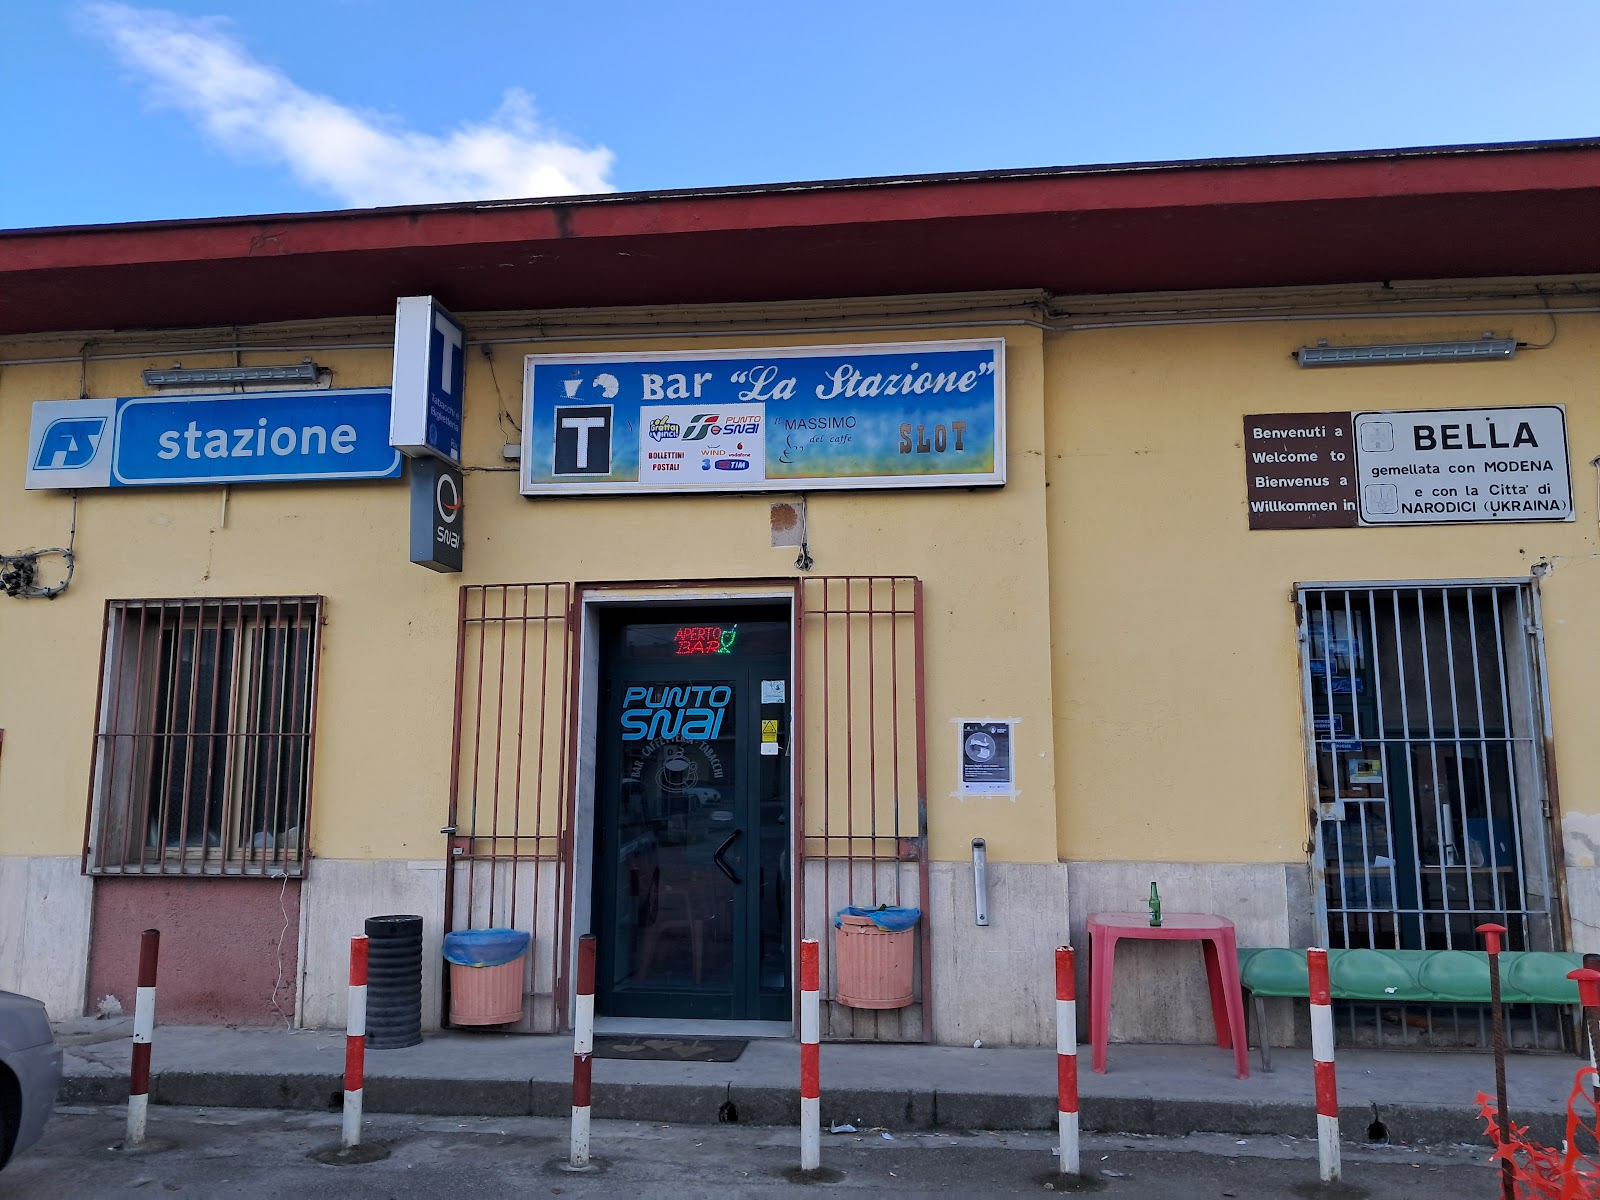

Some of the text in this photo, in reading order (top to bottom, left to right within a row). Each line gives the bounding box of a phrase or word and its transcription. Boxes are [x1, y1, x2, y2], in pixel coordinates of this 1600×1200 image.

[434, 310, 462, 395] T
[641, 373, 712, 400] Bar
[725, 415, 762, 424] PUNTO
[784, 415, 857, 431] MASSIMO
[158, 417, 357, 461] stazione
[809, 434, 824, 443] del
[899, 421, 967, 454] SLOT
[1253, 426, 1343, 439] Benvenuti a
[1413, 421, 1539, 451] BELLA
[562, 417, 605, 469] T
[702, 459, 711, 470] 3
[1252, 450, 1346, 464] Welcome to
[730, 461, 746, 469] TIM
[1371, 460, 1553, 478] gemellata con MODENA
[1255, 475, 1348, 488] Bienvenus a
[1414, 490, 1423, 498] e
[1432, 488, 1458, 497] con
[1466, 484, 1479, 496] la
[1538, 483, 1551, 495] di
[1251, 498, 1356, 512] Willkommen in
[1401, 499, 1567, 514] NARODICI (UKRAINA)
[674, 627, 722, 641] APERTO
[675, 641, 720, 654] BAR
[623, 686, 732, 708] PUNTO
[698, 740, 723, 778] TABACCHI
